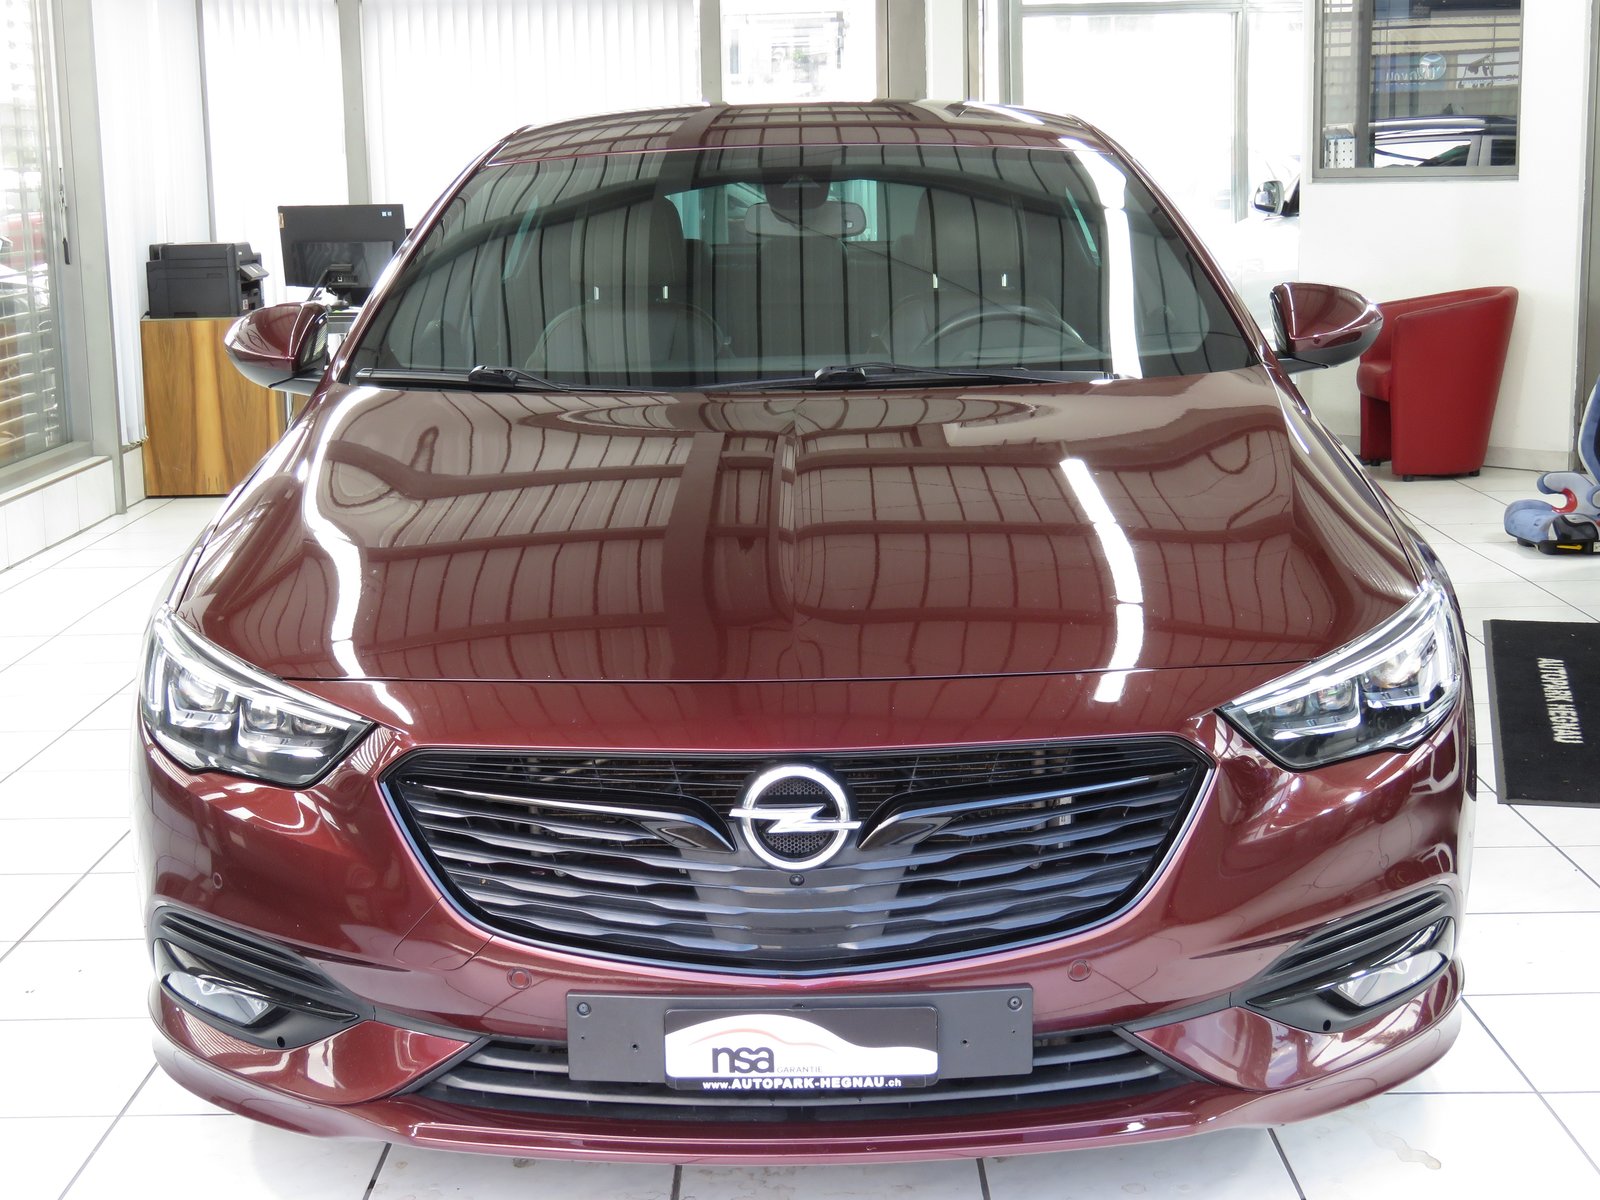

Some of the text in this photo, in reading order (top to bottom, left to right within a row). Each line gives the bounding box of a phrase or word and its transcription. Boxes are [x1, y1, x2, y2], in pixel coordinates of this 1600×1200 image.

[1537, 657, 1584, 744] AUTOPARK HEGNAU
[712, 1047, 823, 1074] nsa GARANTIE
[702, 1076, 902, 1090] www.AUTOPARK-HEGNAU.ch
